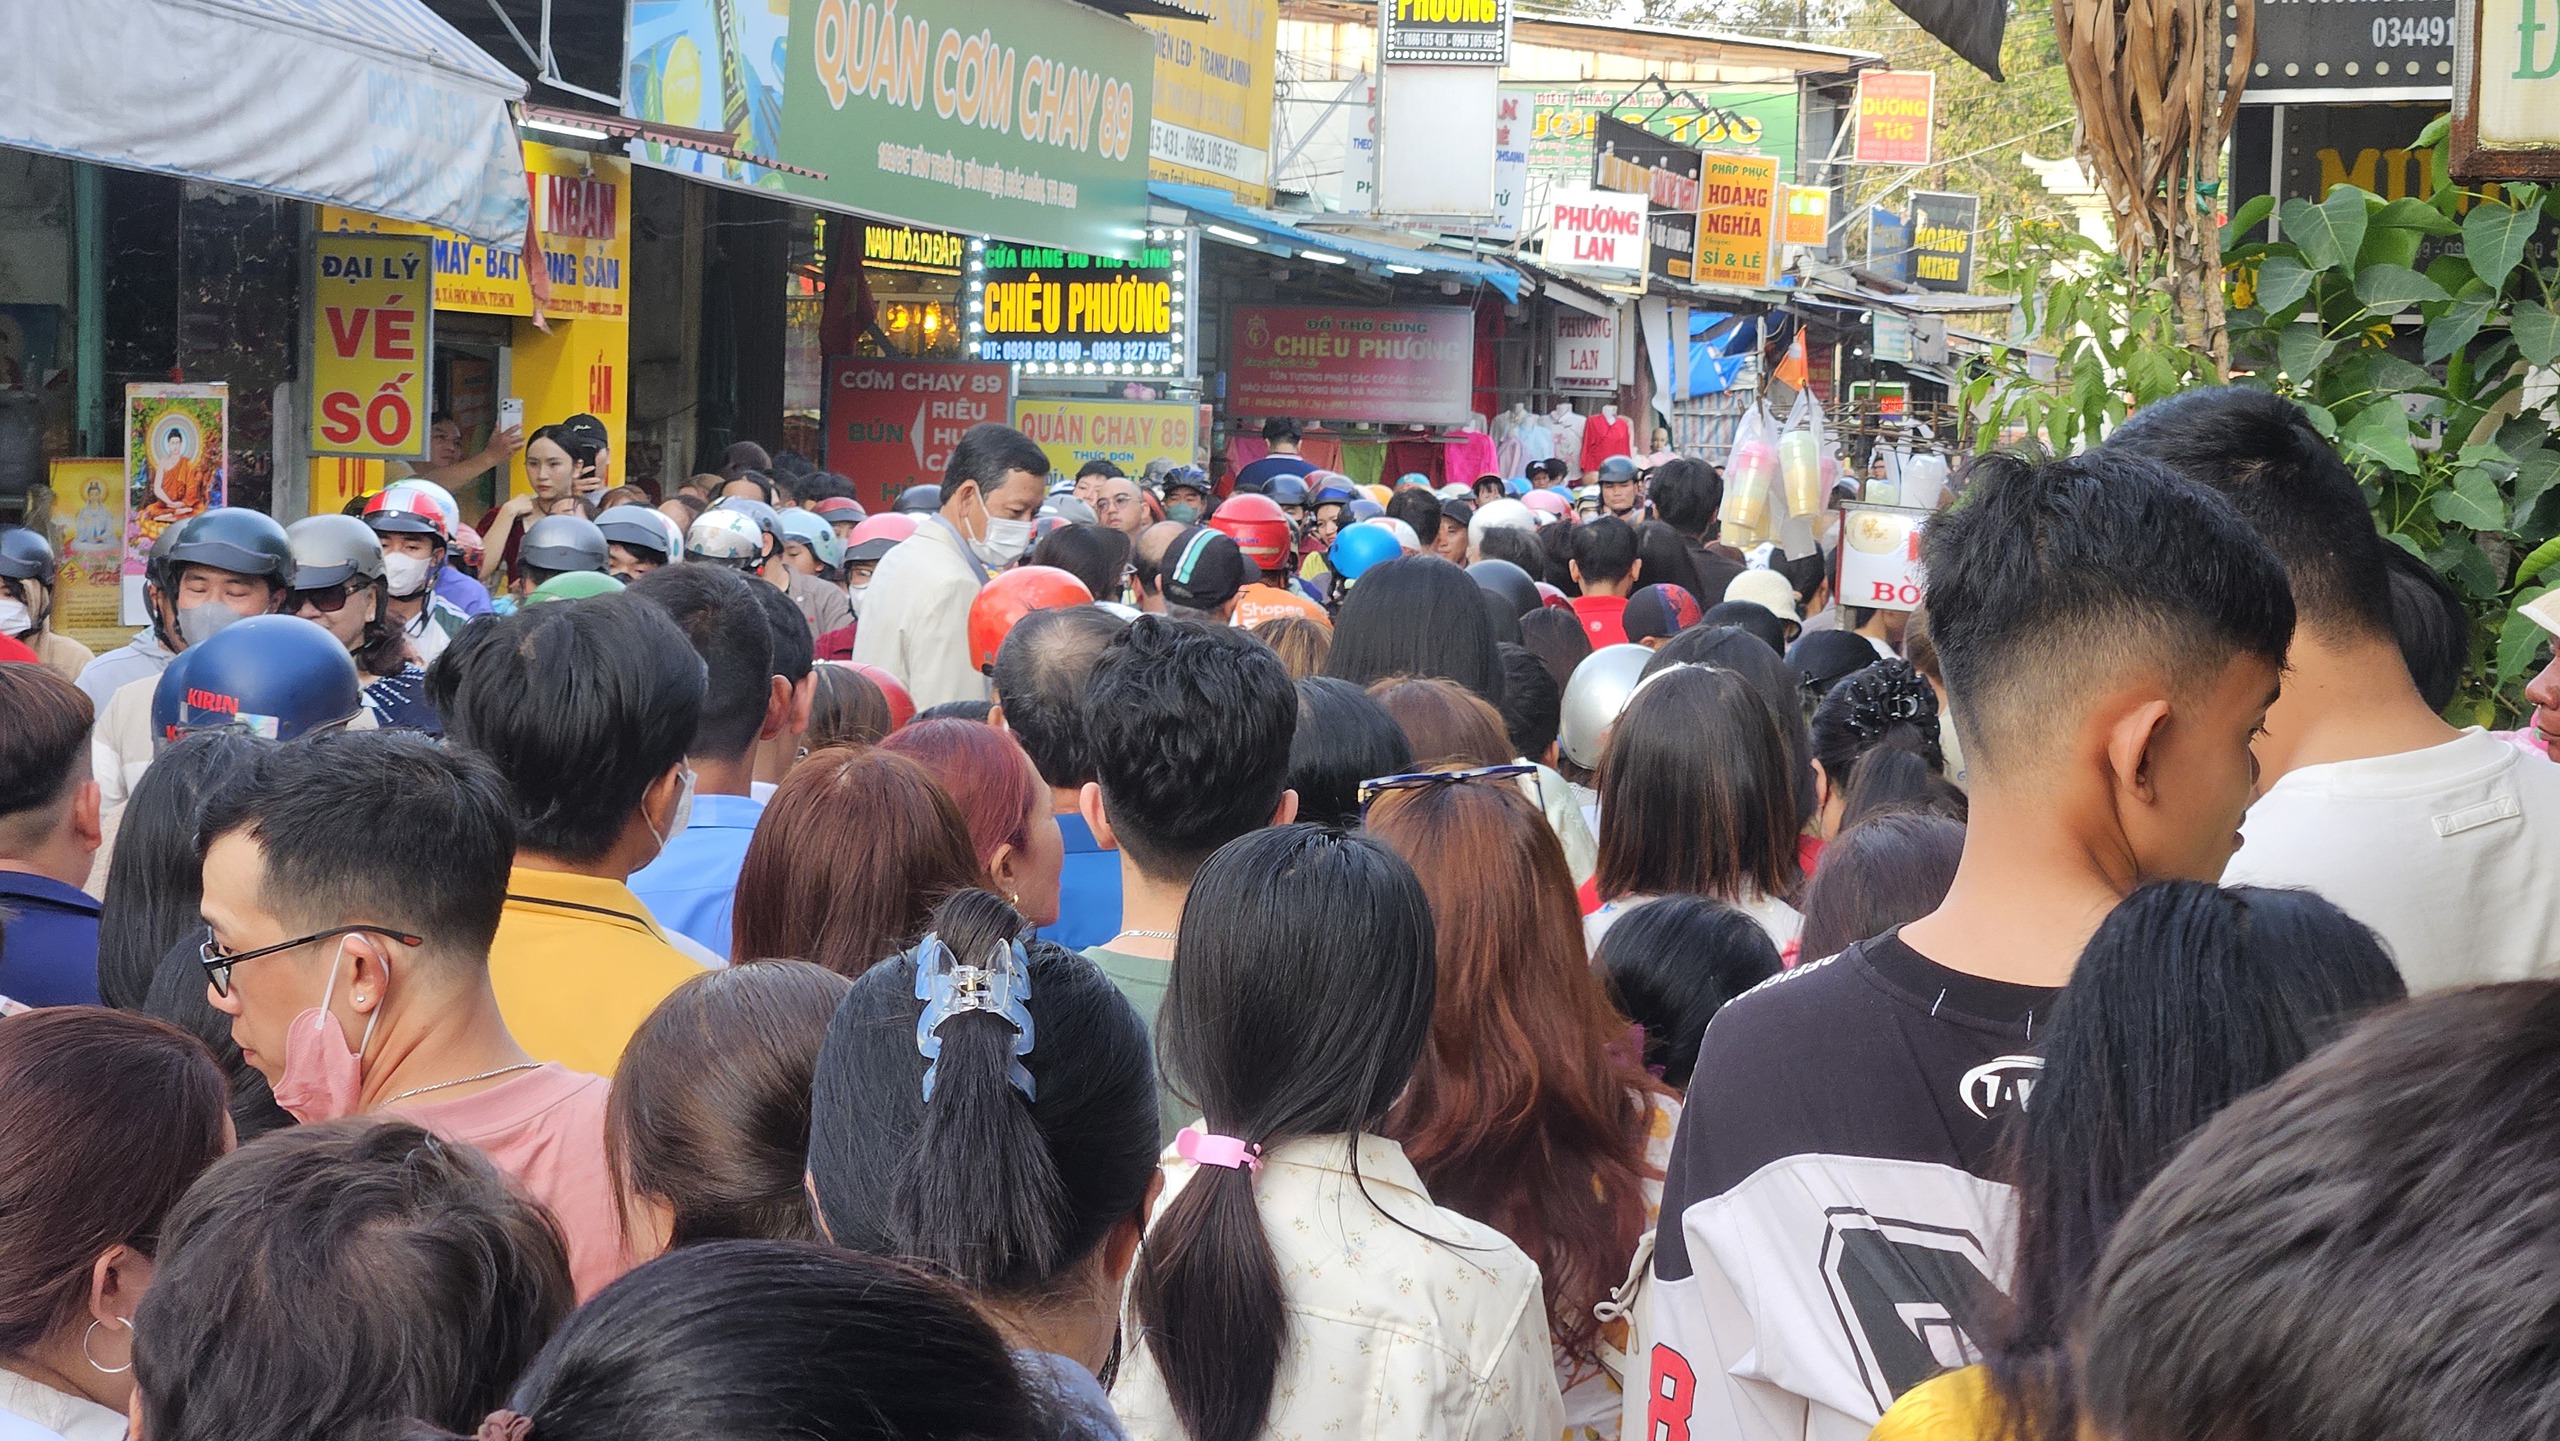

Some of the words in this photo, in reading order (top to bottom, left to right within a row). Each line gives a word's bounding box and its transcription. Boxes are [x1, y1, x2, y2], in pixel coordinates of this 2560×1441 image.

[1175, 36, 1192, 67] LED
[815, 0, 929, 111] QUÁN
[934, 28, 1015, 134] CƠM
[1019, 55, 1099, 152] CHAY
[1099, 77, 1133, 161] 89
[1862, 95, 1927, 118] DƯƠNG
[1873, 117, 1913, 140] TÚC
[1164, 128, 1179, 157] 431
[1185, 134, 1205, 163] 0968
[1207, 140, 1222, 167] 105
[1742, 165, 1768, 181] PHỤC
[1708, 180, 1767, 208] HOÀNG
[1554, 203, 1640, 236] PHƯƠNG
[1707, 211, 1762, 237] NGHĨA
[865, 226, 892, 259] NAM
[893, 225, 911, 262] MÔ
[911, 232, 920, 263] A
[921, 233, 932, 264] DI
[1574, 235, 1615, 262] LAN
[321, 255, 372, 284] ĐẠI
[383, 252, 420, 280] LÝ
[434, 233, 471, 276] MÁY
[583, 246, 619, 290] SẢN
[1725, 253, 1737, 266] &
[1743, 251, 1762, 269] LẺ
[1916, 255, 1960, 281] MINH
[984, 272, 1061, 334] CHIÊU
[1068, 274, 1171, 334] PHƯƠNG
[325, 294, 416, 360] VÉ
[1307, 316, 1332, 330] ĐỒ
[1339, 317, 1373, 332] THỜ
[1379, 320, 1428, 334] CÚNG
[1003, 341, 1032, 360] 0938
[1034, 341, 1057, 360] 628
[1059, 341, 1081, 360] 090
[1092, 341, 1121, 360] 0938
[1123, 341, 1146, 360] 327
[1147, 341, 1171, 360] 975
[1274, 331, 1350, 358] CHIÊU
[1570, 349, 1599, 370] LAN
[840, 369, 894, 391] CƠM
[901, 372, 965, 393] CHAY
[970, 374, 1002, 393] 89
[321, 372, 416, 446] SỐ
[932, 397, 987, 420] RIÊU
[848, 417, 904, 444] BÚN
[1022, 405, 1084, 444] QUÁN
[1091, 415, 1154, 447] CHAY
[1161, 418, 1189, 448] 89
[1109, 451, 1135, 462] ĐƠN
[1871, 575, 1921, 605] BÒ
[1241, 601, 1305, 617] Shopee
[187, 687, 240, 716] KIRIN
